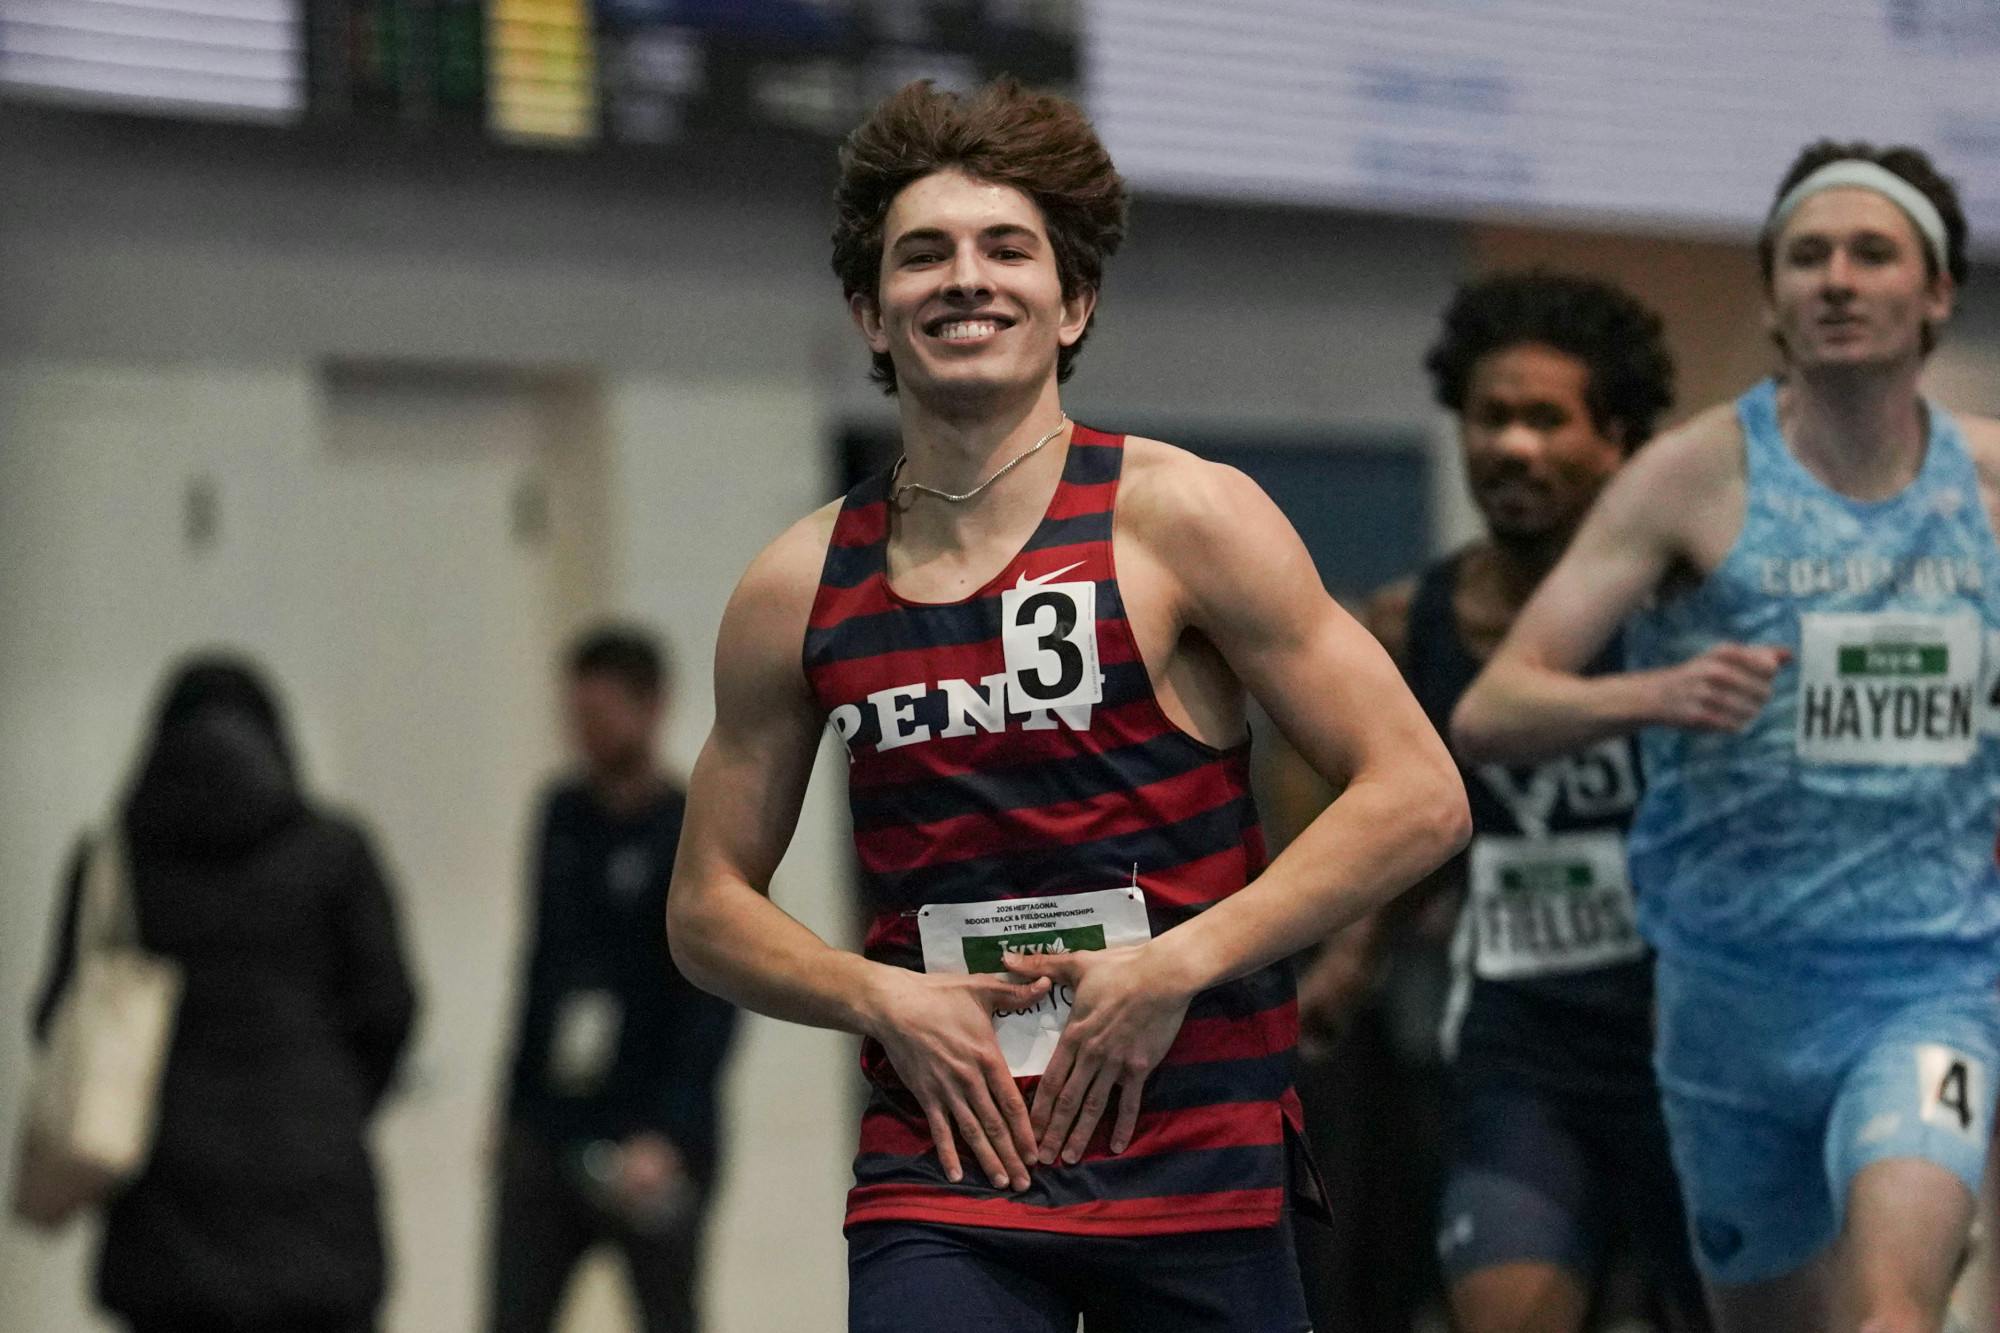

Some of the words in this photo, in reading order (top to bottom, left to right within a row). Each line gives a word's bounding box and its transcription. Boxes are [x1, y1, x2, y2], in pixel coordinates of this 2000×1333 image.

[1015, 591, 1083, 700] 3
[1803, 685, 1972, 739] HAYDEN
[965, 917, 990, 925] INDOOR
[991, 914, 1014, 924] TRACK
[996, 905, 1013, 913] 2026
[1013, 902, 1058, 912] HEPTAGONAL
[1014, 923, 1026, 931] THE
[1028, 921, 1057, 929] ARMORY
[1938, 1062, 1972, 1129] 4
